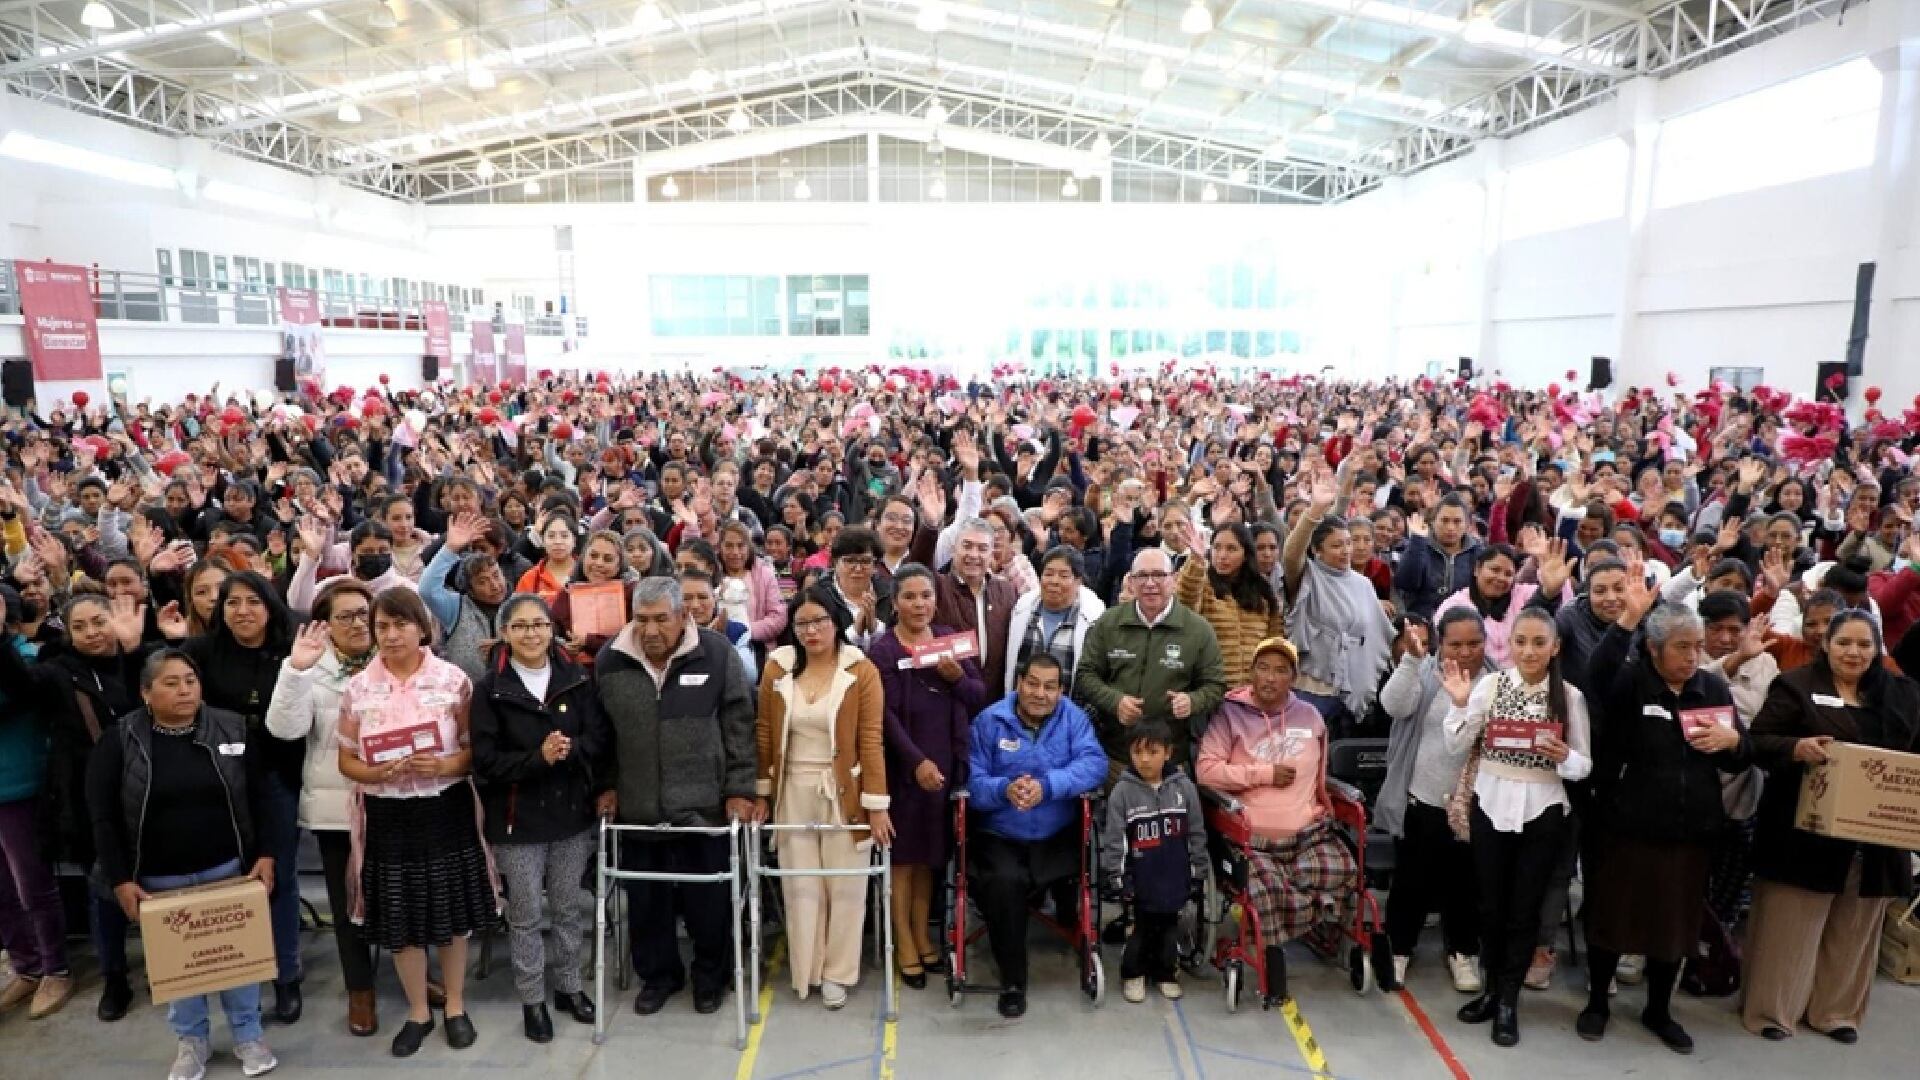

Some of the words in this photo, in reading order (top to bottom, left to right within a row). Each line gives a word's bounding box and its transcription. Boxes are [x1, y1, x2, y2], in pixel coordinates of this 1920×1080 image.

[37, 315, 72, 331] Mujeres
[44, 335, 86, 347] Bienestar
[1896, 767, 1920, 775] ESTAD
[193, 944, 234, 959] CANASTA
[184, 952, 245, 969] ALIMENTARIA
